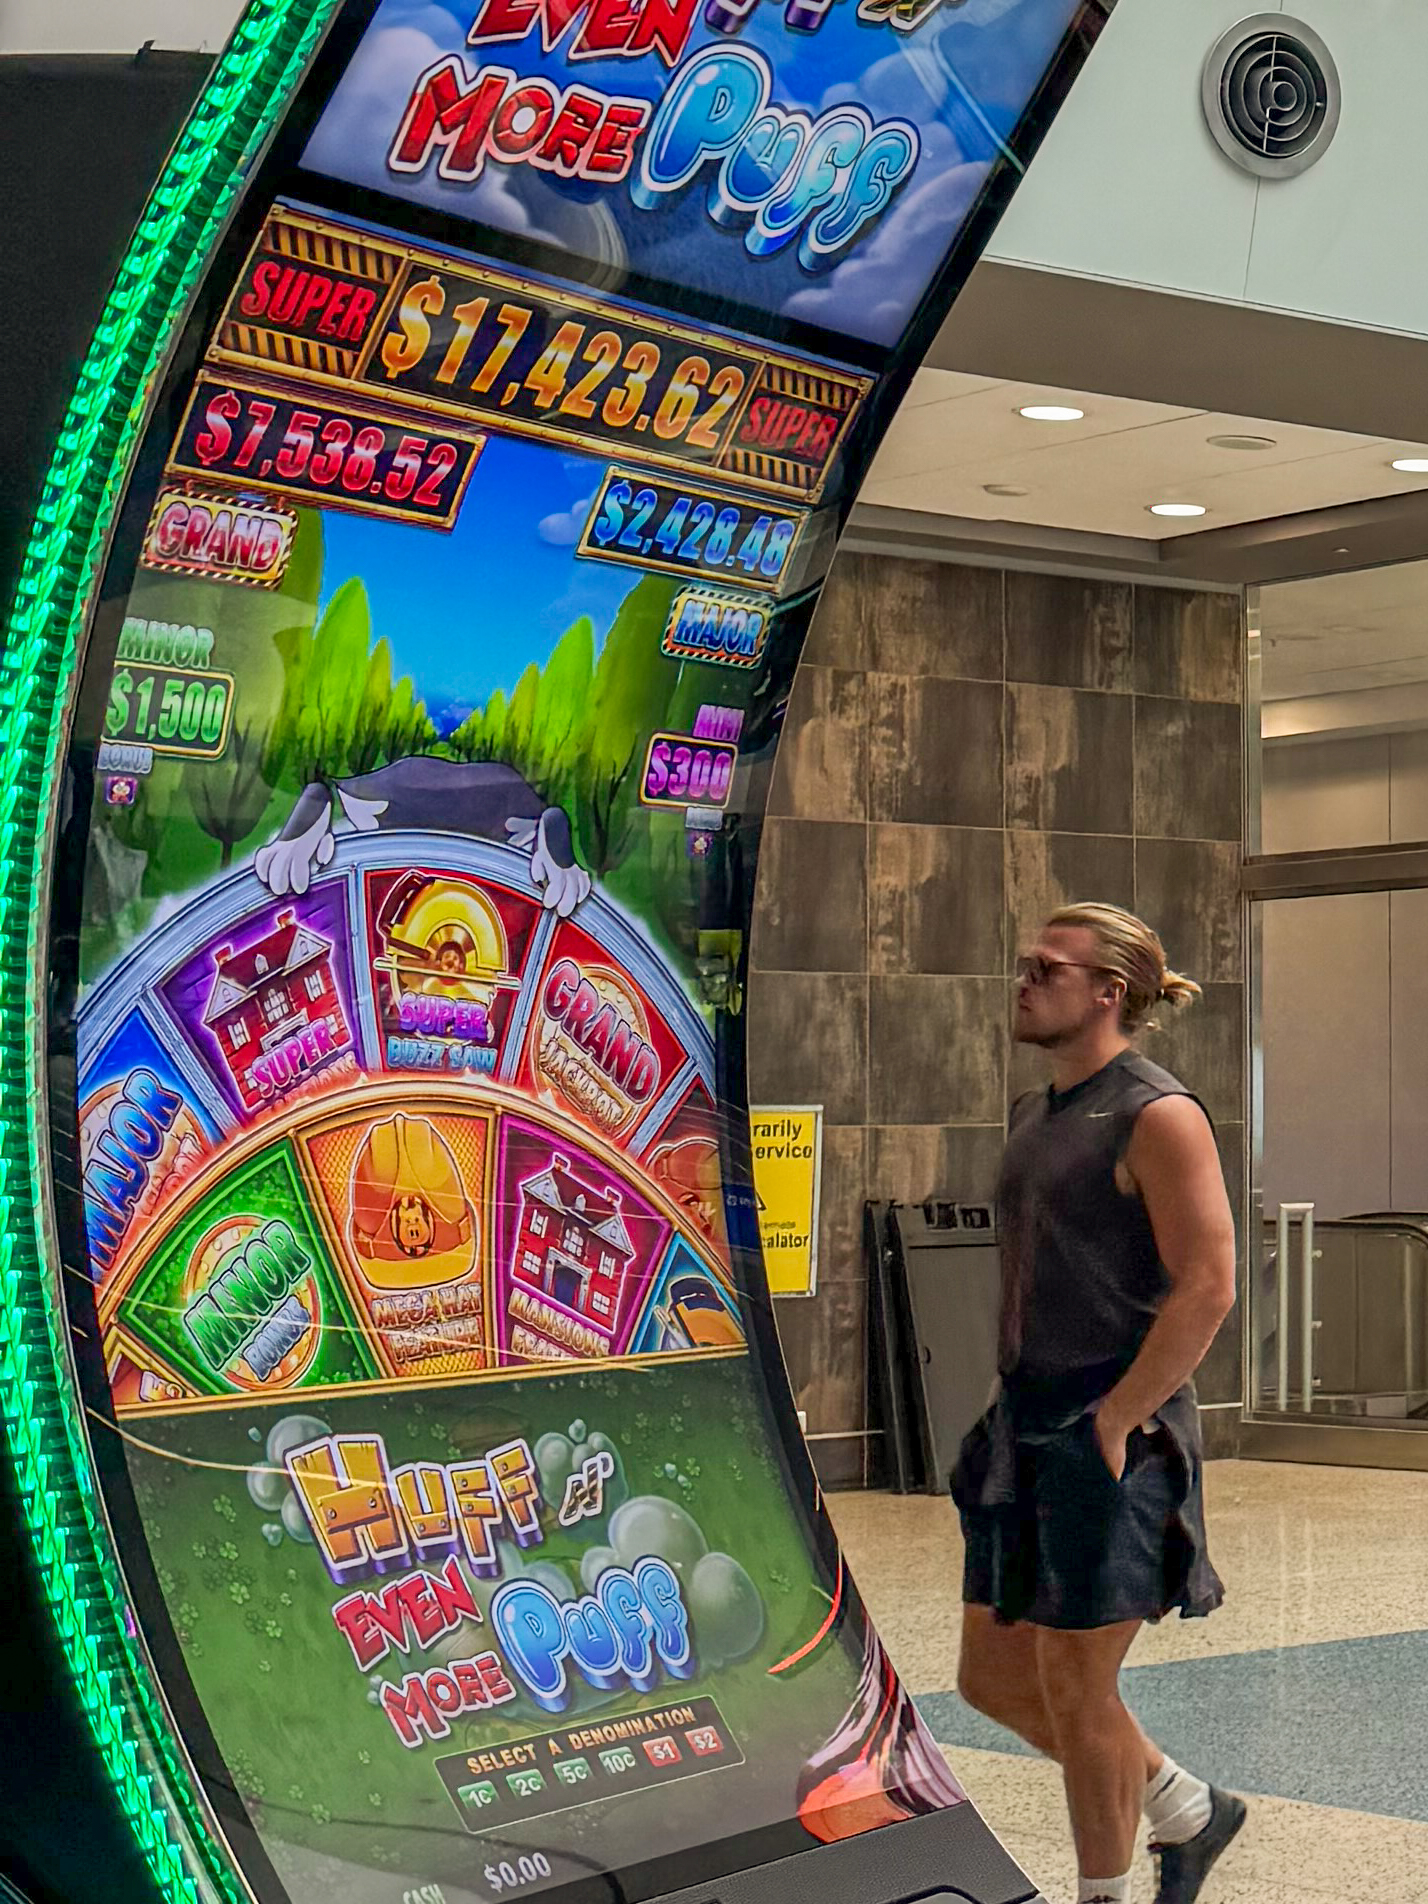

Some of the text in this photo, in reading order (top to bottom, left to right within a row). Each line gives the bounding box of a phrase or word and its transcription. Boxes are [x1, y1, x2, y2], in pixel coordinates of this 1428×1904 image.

[388, 40, 921, 273] MORE PUFF
[240, 261, 839, 461] SUPER $17,423.62 SUPER
[195, 390, 460, 509] $7,538.52
[151, 502, 285, 574] GRAND
[595, 478, 795, 577] $2,428.48
[116, 617, 214, 669] MINOR
[674, 596, 766, 657] MAJOR
[106, 668, 226, 743] $1,500
[648, 742, 731, 800] $300
[400, 993, 488, 1040] SUPER
[543, 958, 661, 1104] GRAND
[252, 1018, 338, 1098] SUPER
[752, 1119, 802, 1140] rarily
[755, 1142, 813, 1161] ervice
[184, 1220, 312, 1371] MINOR
[284, 1434, 546, 1585] HUFF
[332, 1554, 482, 1673] EVEN
[379, 1554, 695, 1749] MORE PUFF
[467, 1706, 697, 1775] SELECT A DENOMINATION
[651, 1742, 676, 1761] $1
[694, 1731, 719, 1750] $2
[484, 1852, 552, 1893] $0.00
